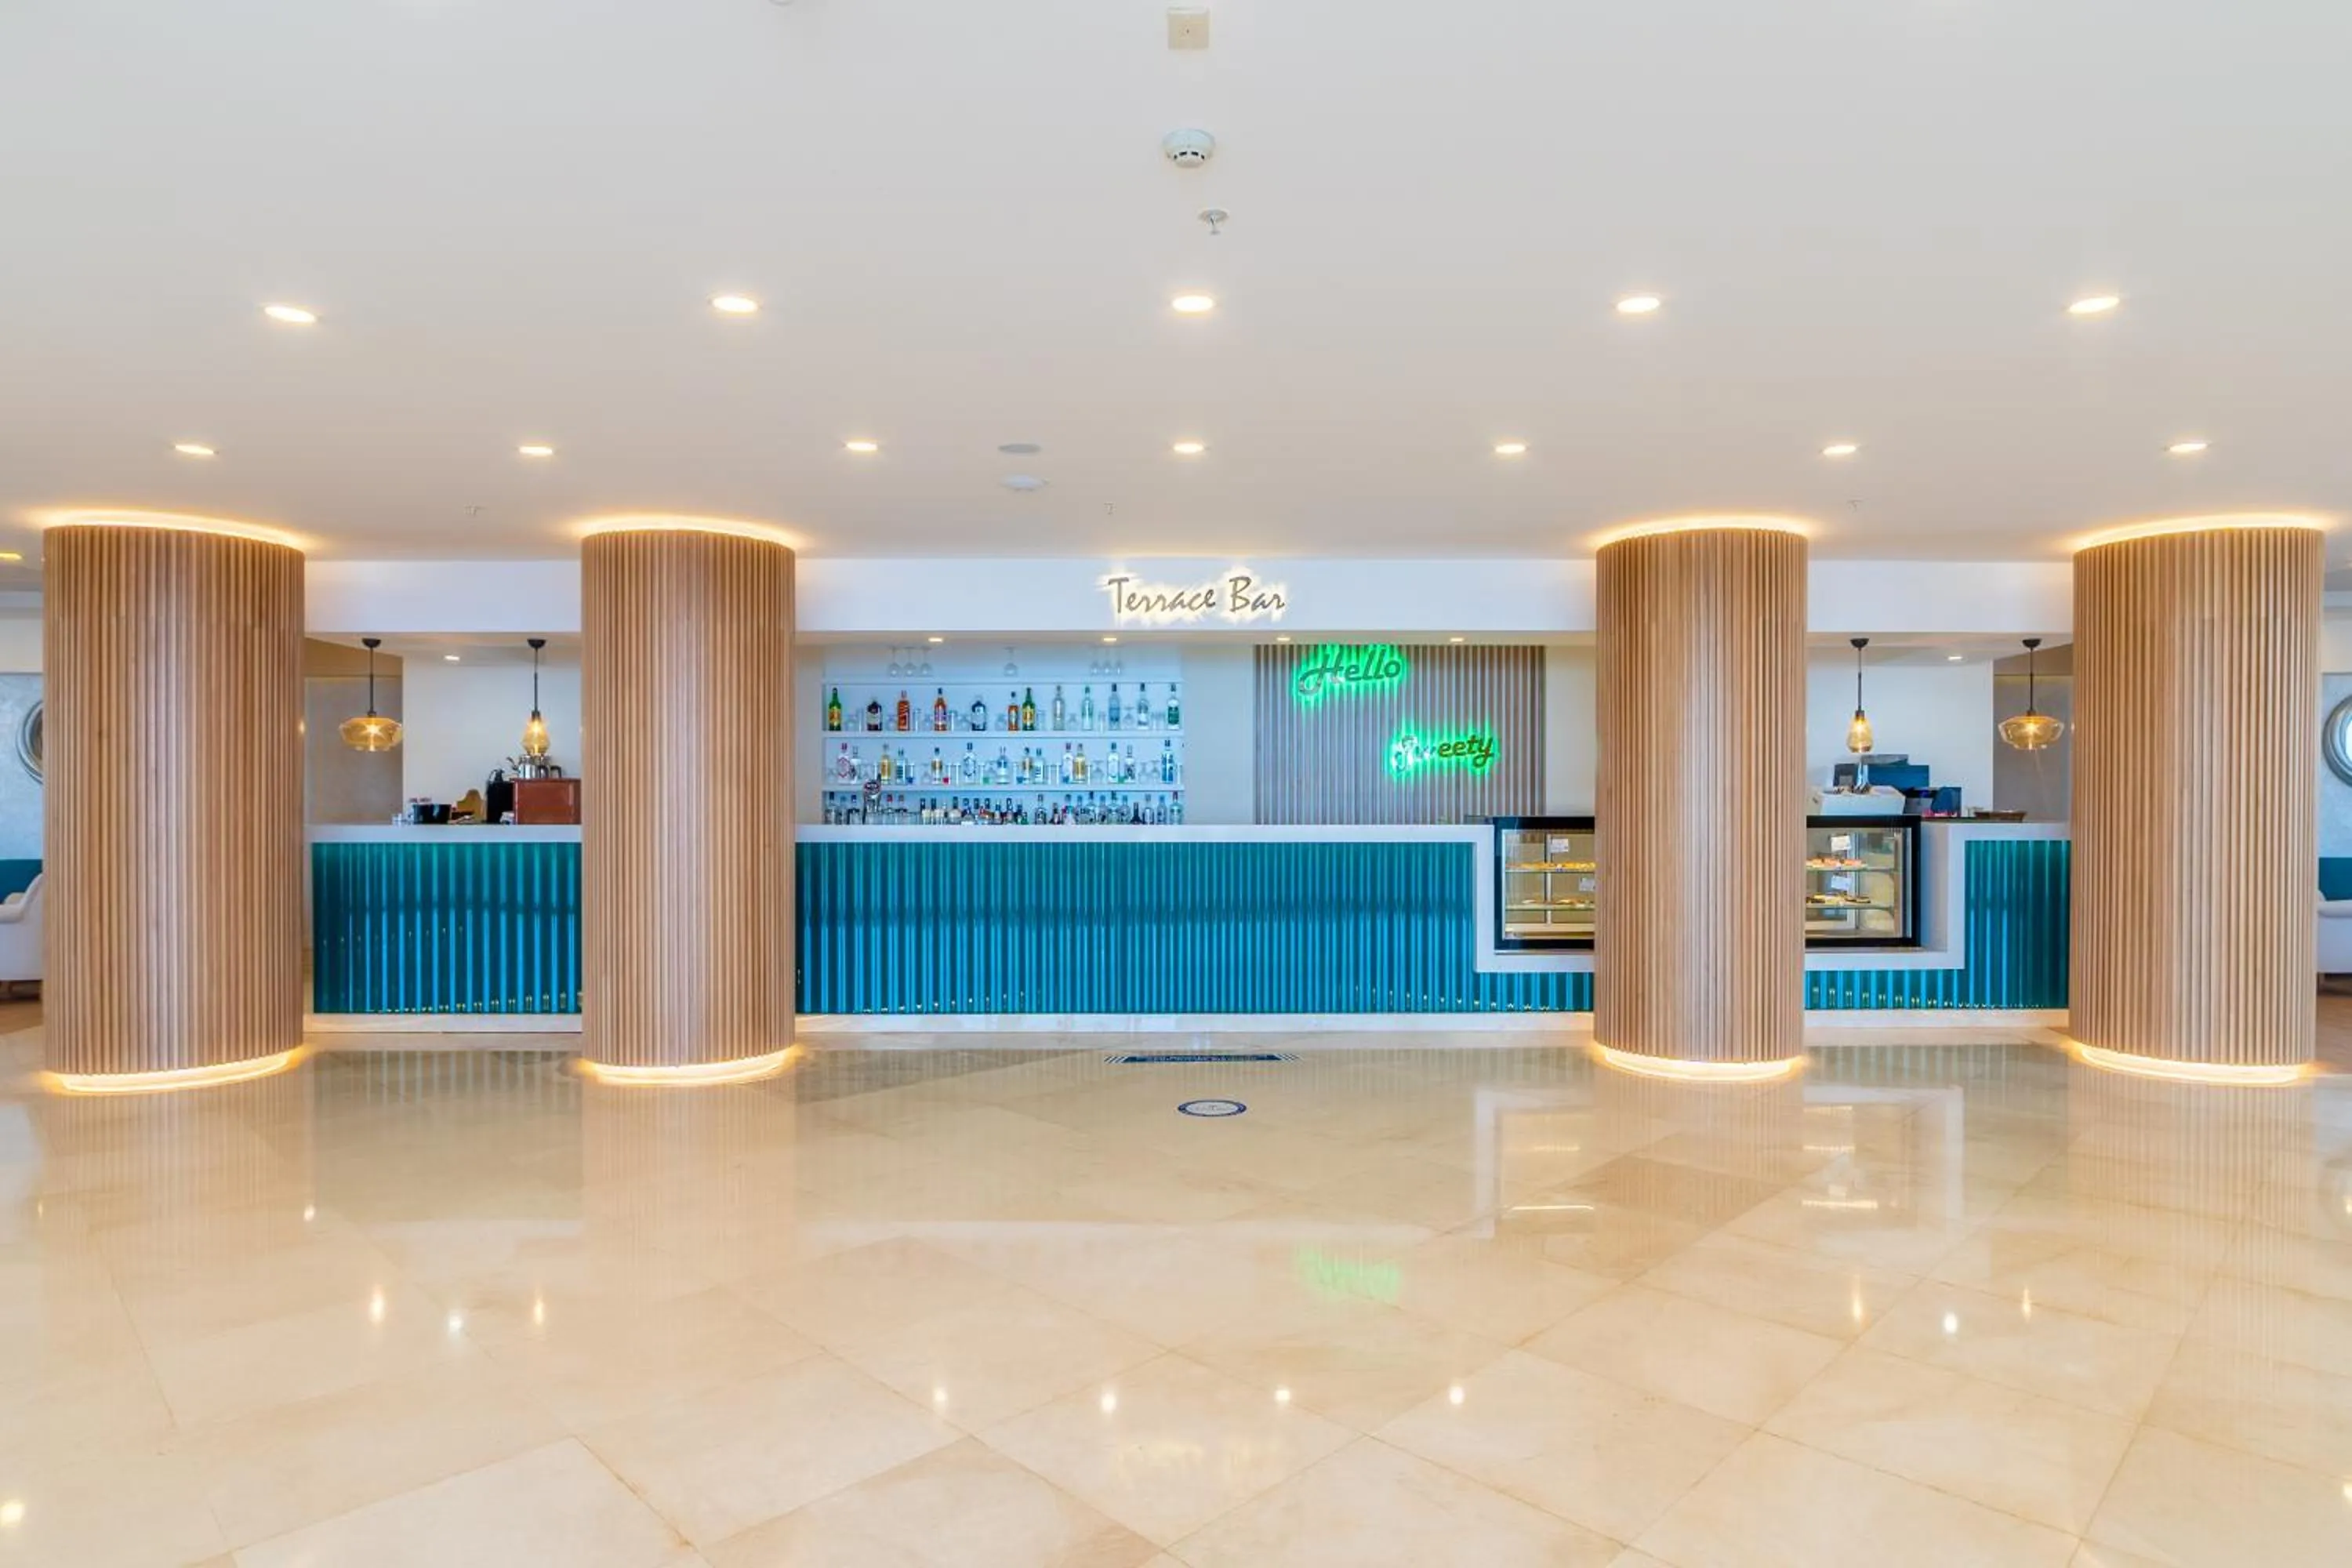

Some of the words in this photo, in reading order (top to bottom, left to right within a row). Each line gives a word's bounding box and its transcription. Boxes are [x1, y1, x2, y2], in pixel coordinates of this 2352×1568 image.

[1107, 576, 1216, 614] Terrace
[1229, 575, 1286, 612] Bar
[1298, 645, 1402, 695] Hello
[1392, 734, 1494, 771] Sweety
